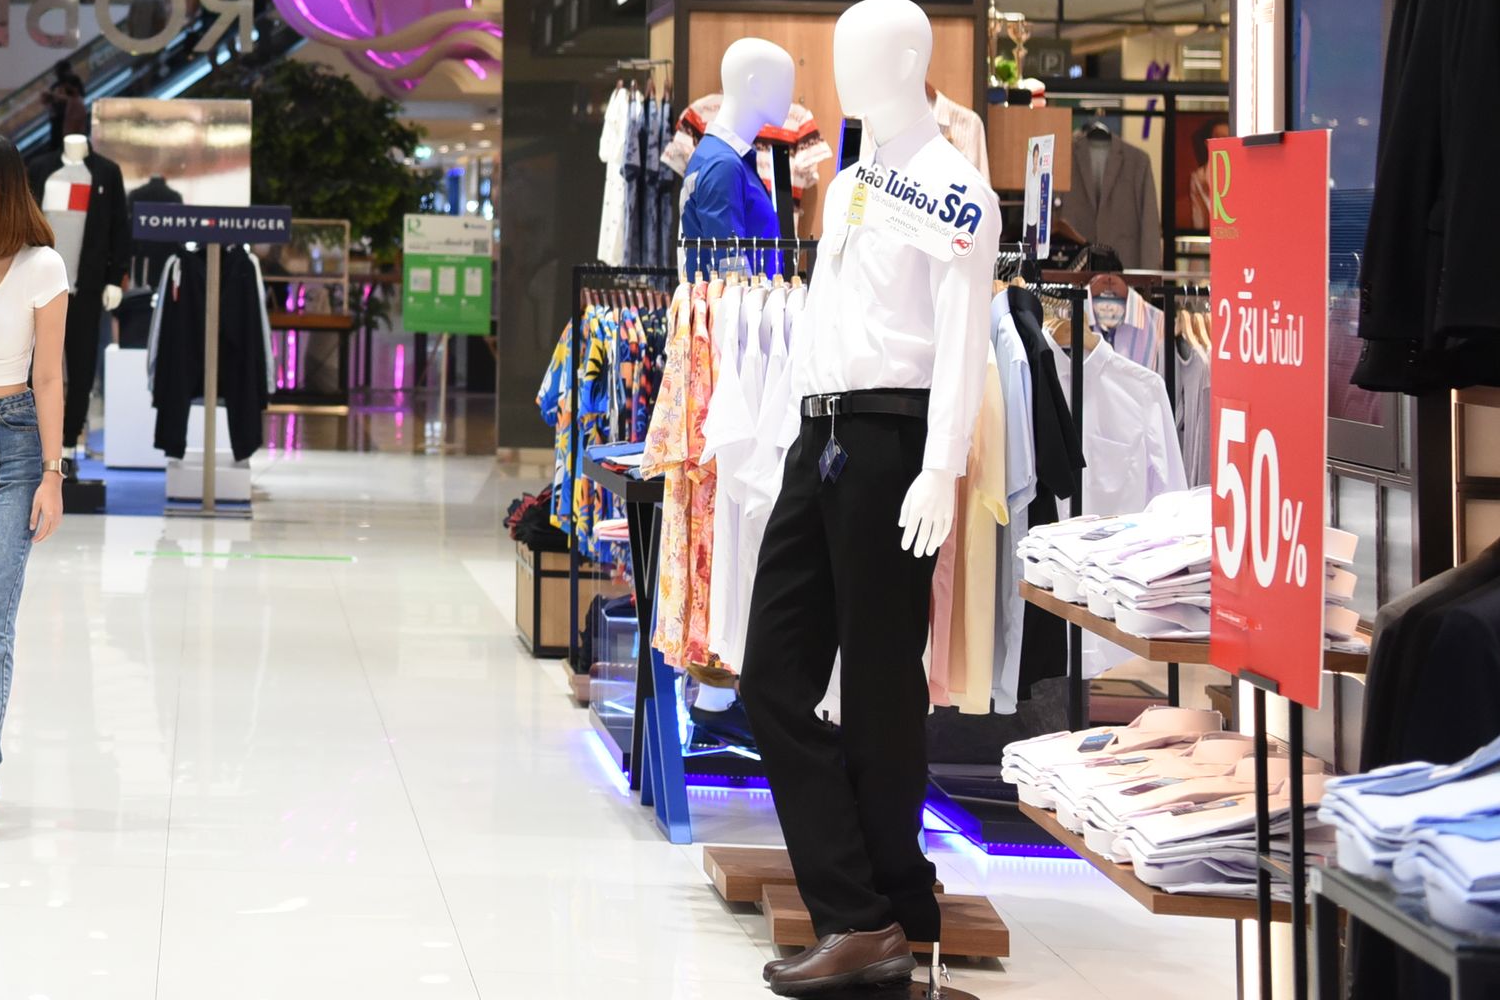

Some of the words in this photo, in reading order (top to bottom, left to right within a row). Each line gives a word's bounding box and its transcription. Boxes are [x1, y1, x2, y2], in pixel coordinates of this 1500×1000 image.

[138, 215, 198, 227] TOMMY
[218, 218, 285, 230] HILFIGER
[855, 166, 884, 189] หล่อ
[884, 169, 938, 215] ไม่ต้อง
[938, 183, 983, 235] รีด
[1218, 298, 1231, 360] 2
[1238, 268, 1267, 365] ชิ้น
[1214, 408, 1307, 588] 50%
